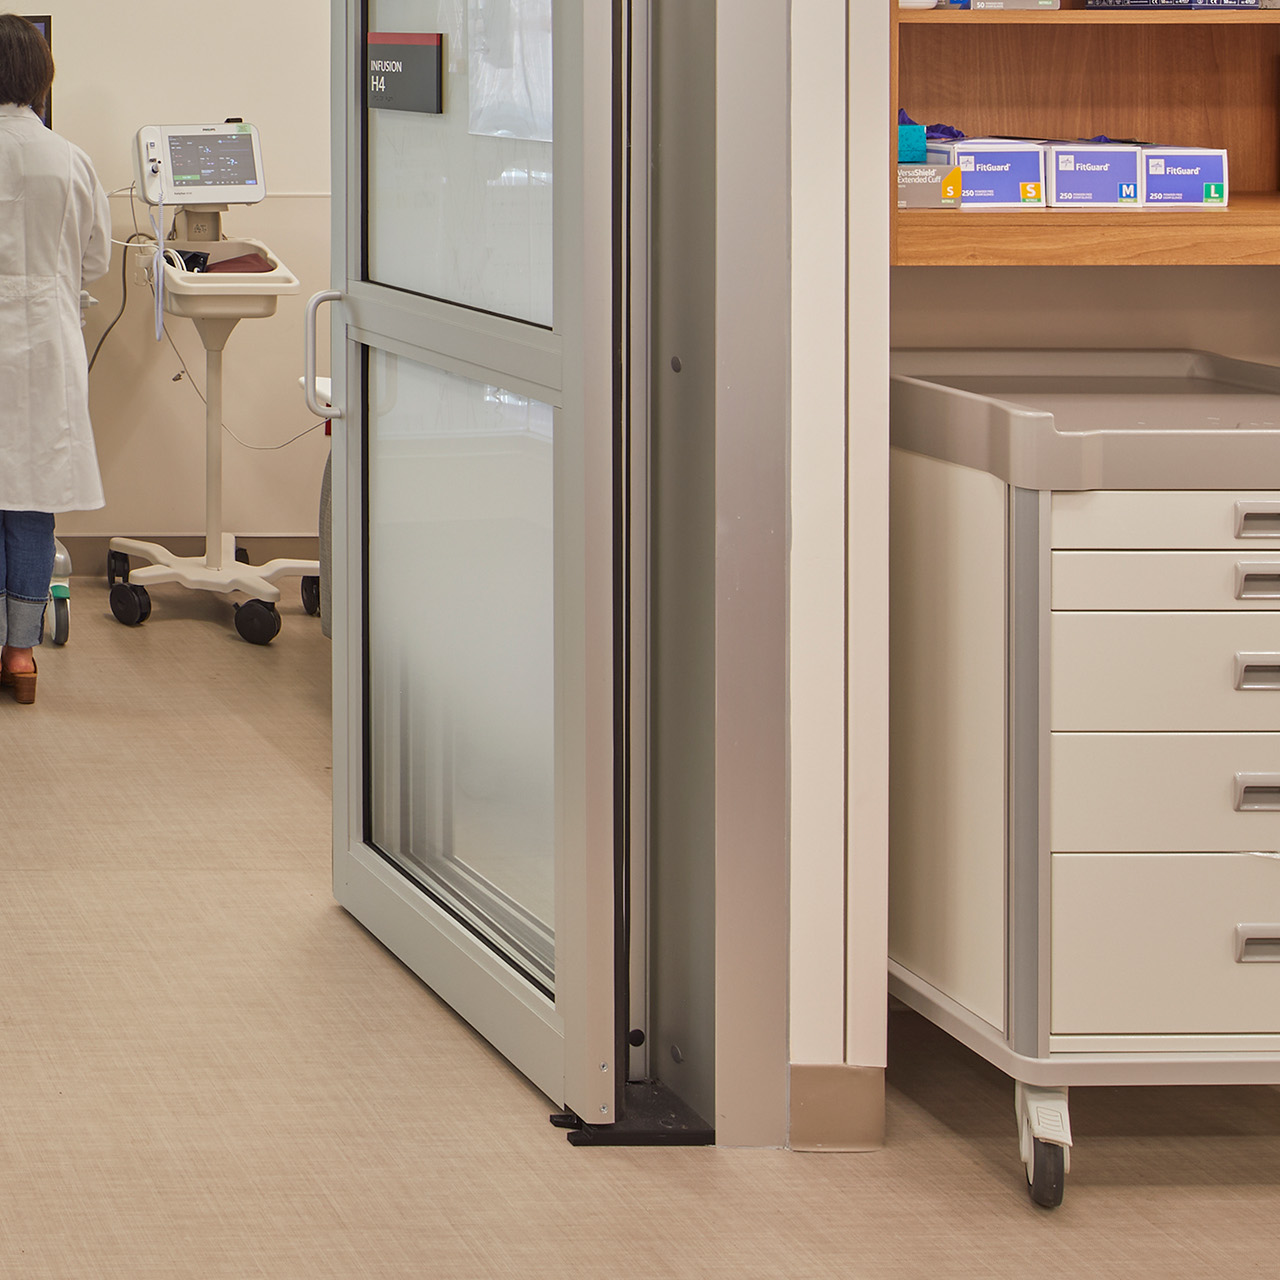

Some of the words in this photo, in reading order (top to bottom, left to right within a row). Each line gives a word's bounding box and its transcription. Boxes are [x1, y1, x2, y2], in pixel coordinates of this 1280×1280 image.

[371, 60, 402, 72] INFUSION
[371, 76, 385, 92] H4
[976, 164, 1009, 172] FitGuard
[1076, 163, 1108, 171] FitGuard
[1166, 167, 1199, 175] FitGuard
[947, 186, 953, 196] S
[1026, 184, 1036, 197] S
[1122, 185, 1134, 197] M
[1211, 185, 1219, 197] L
